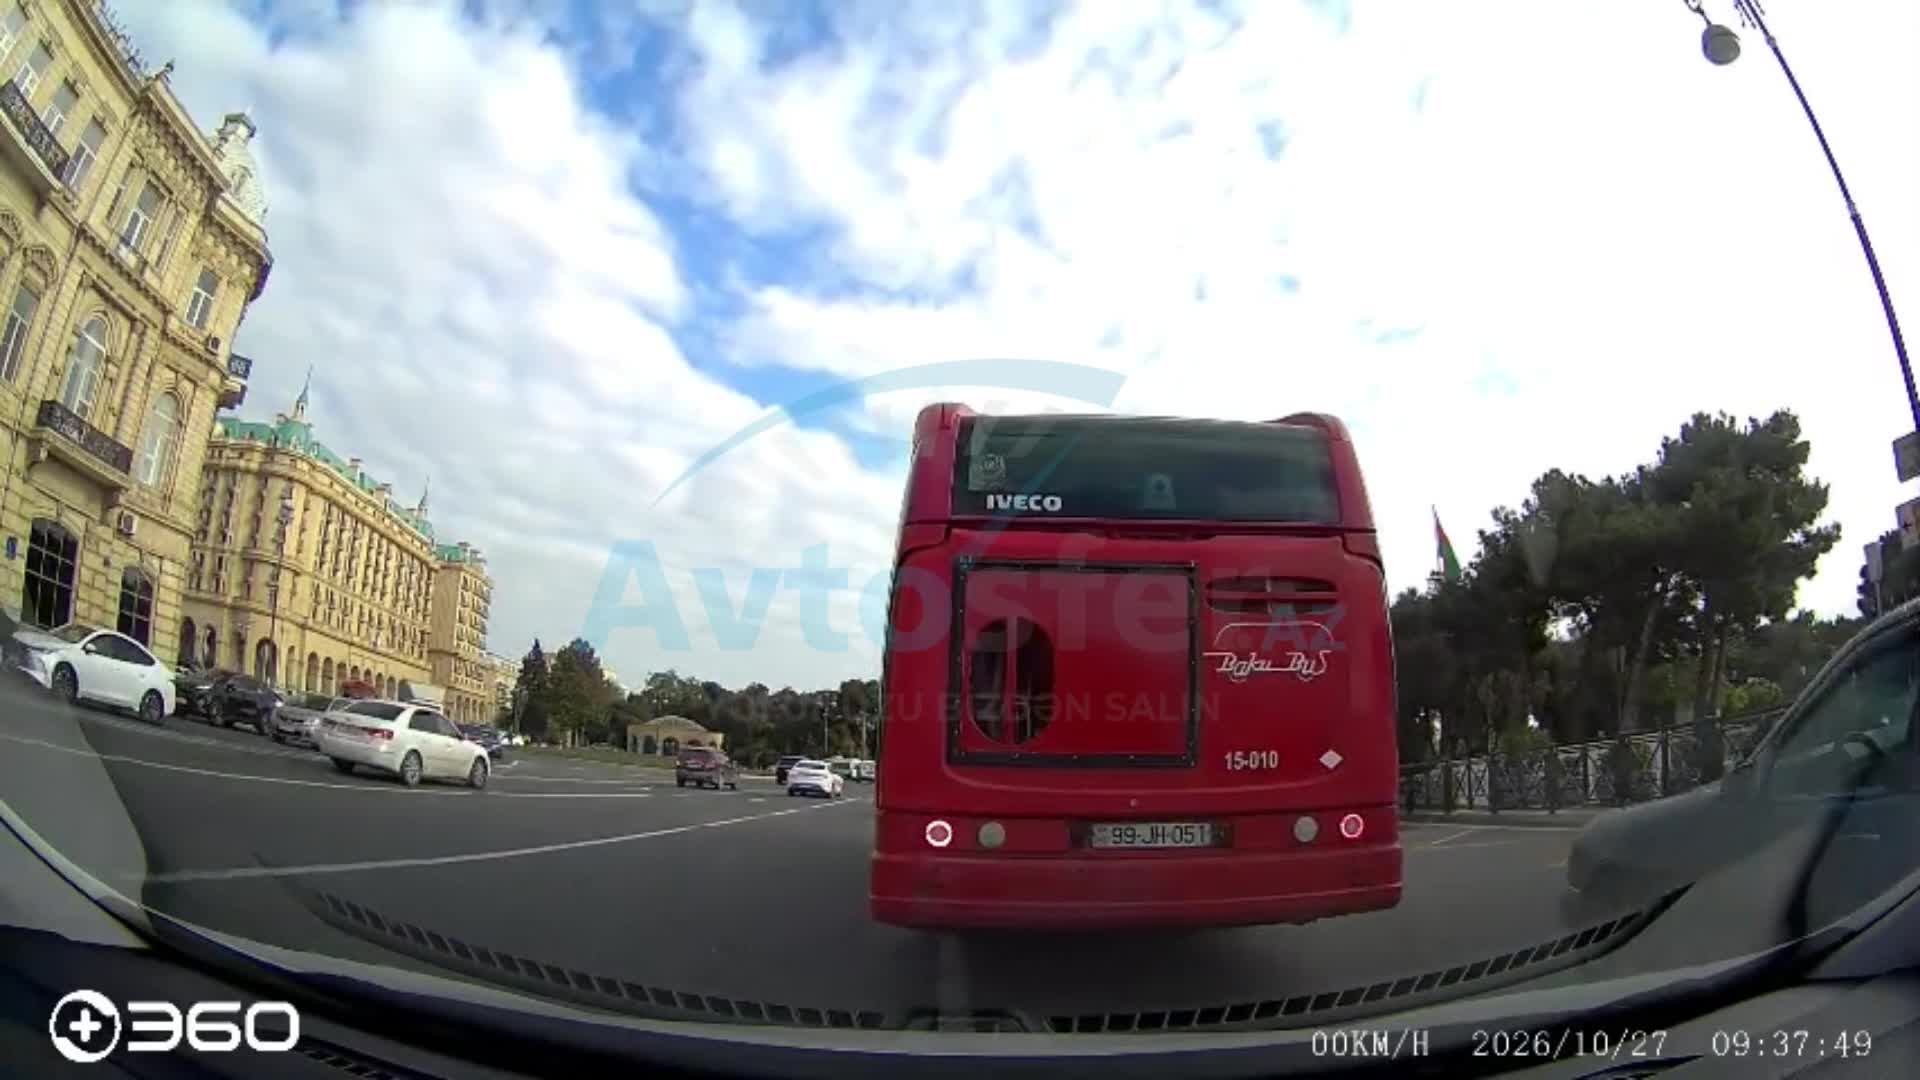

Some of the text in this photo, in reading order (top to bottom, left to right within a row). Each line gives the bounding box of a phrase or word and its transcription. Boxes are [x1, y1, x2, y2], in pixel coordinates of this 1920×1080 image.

[986, 494, 1063, 511] IVECO
[1209, 651, 1272, 681] Baku
[1225, 750, 1279, 769] 15-010
